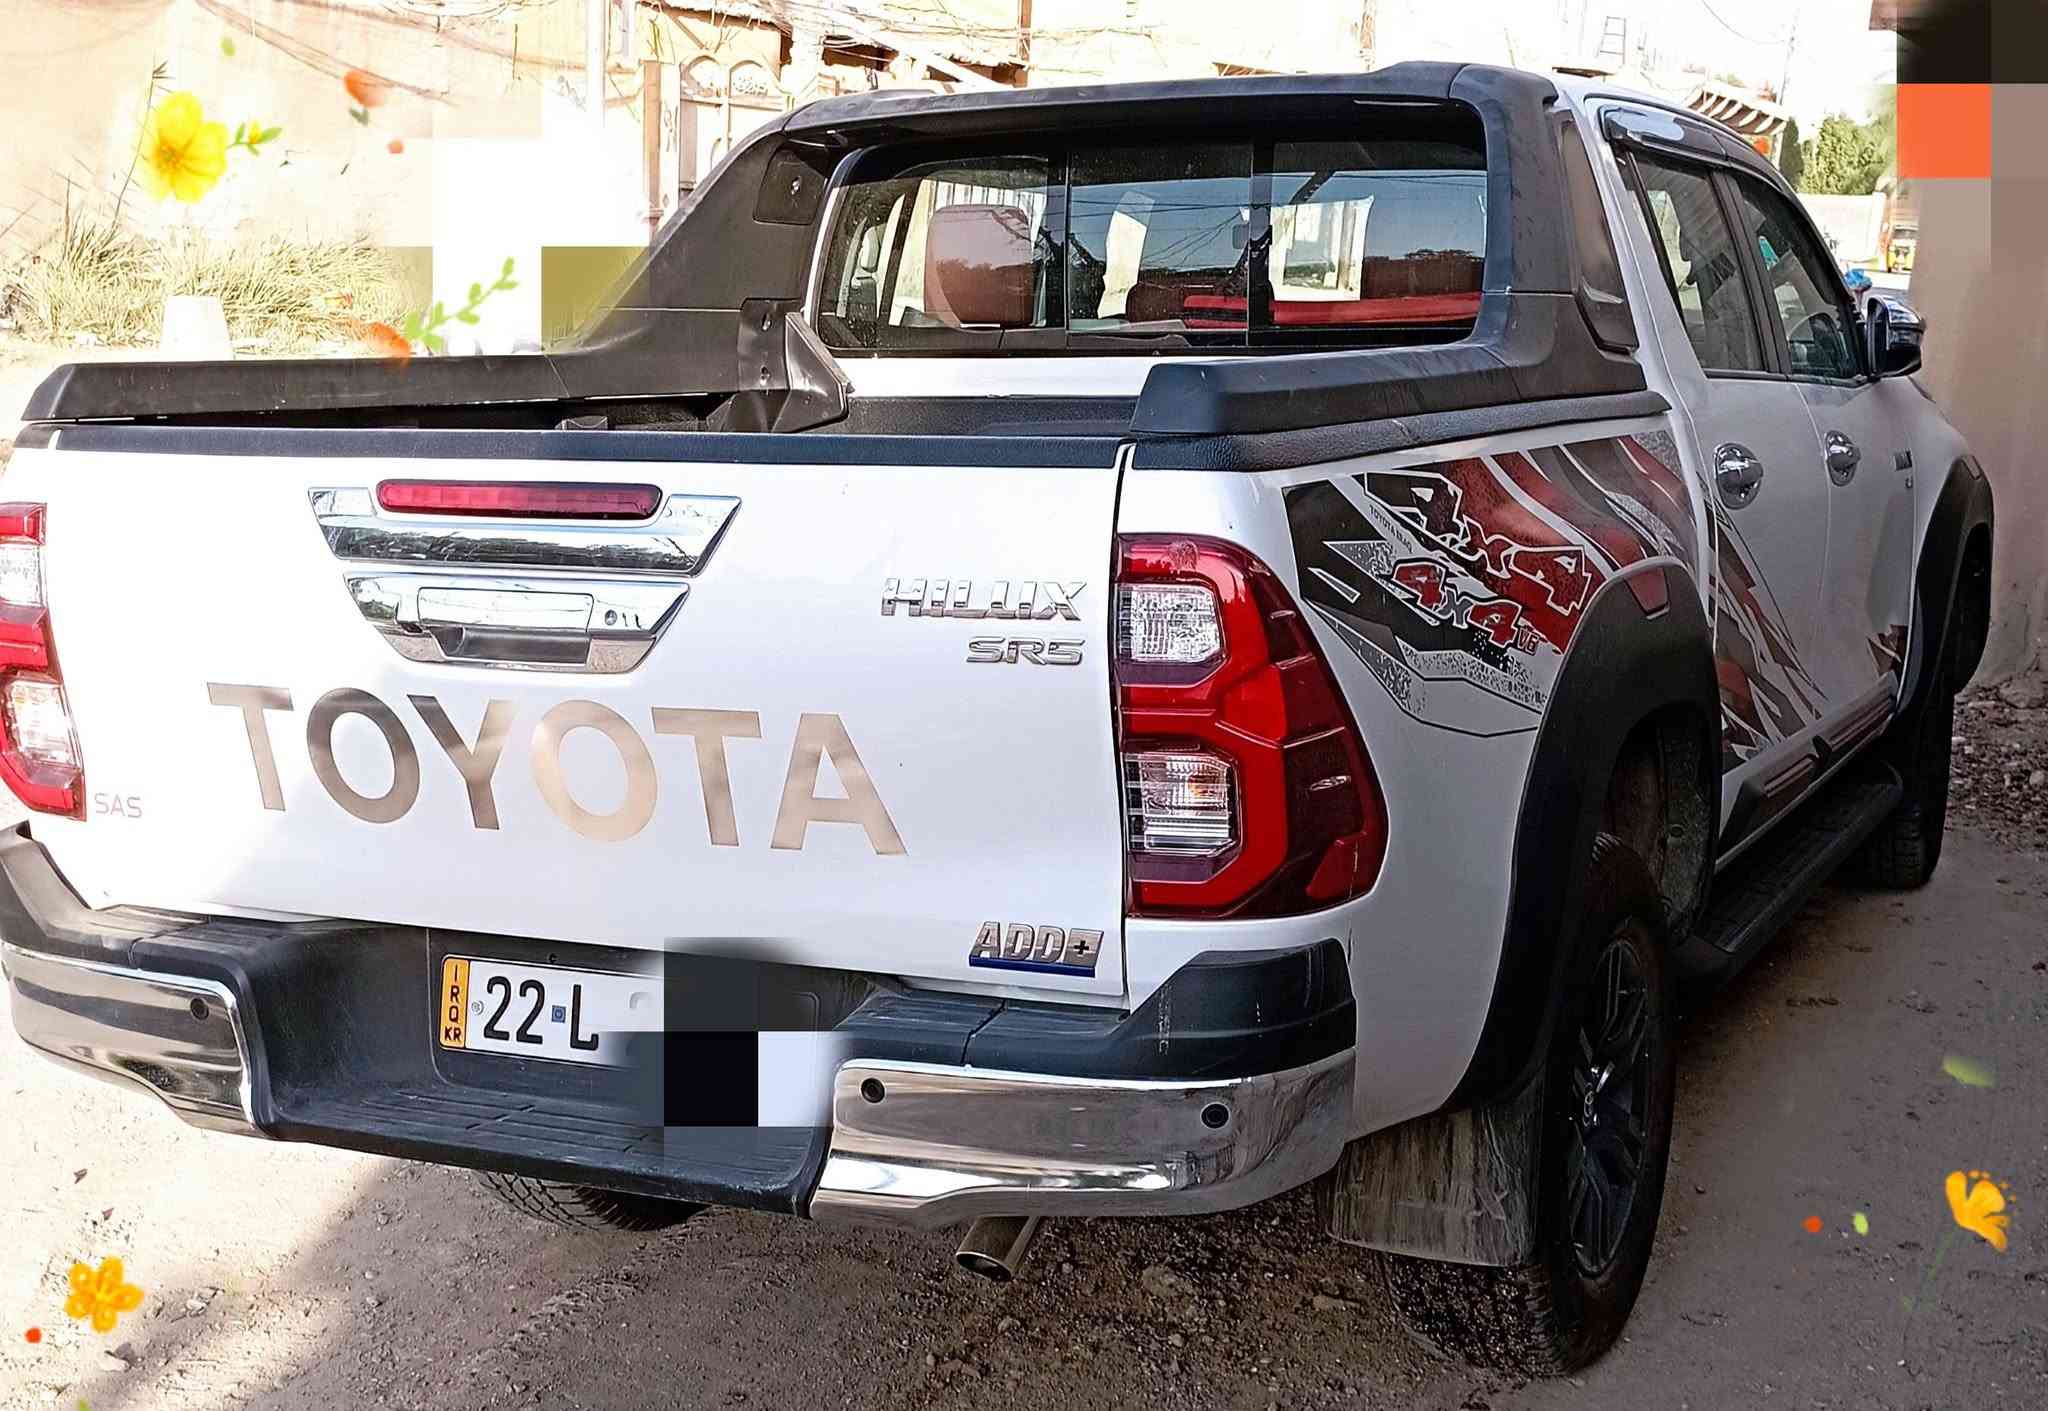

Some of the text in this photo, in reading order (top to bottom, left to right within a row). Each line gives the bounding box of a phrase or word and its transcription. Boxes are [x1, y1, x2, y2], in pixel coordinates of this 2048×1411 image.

[1369, 503, 1396, 536] TOYOTA
[881, 577, 1087, 621] HILUX
[966, 636, 1086, 666] SR5
[206, 681, 908, 856] TOYOTA
[94, 792, 143, 819] SAS
[483, 975, 544, 1046] 22
[444, 1026, 462, 1041] KR
